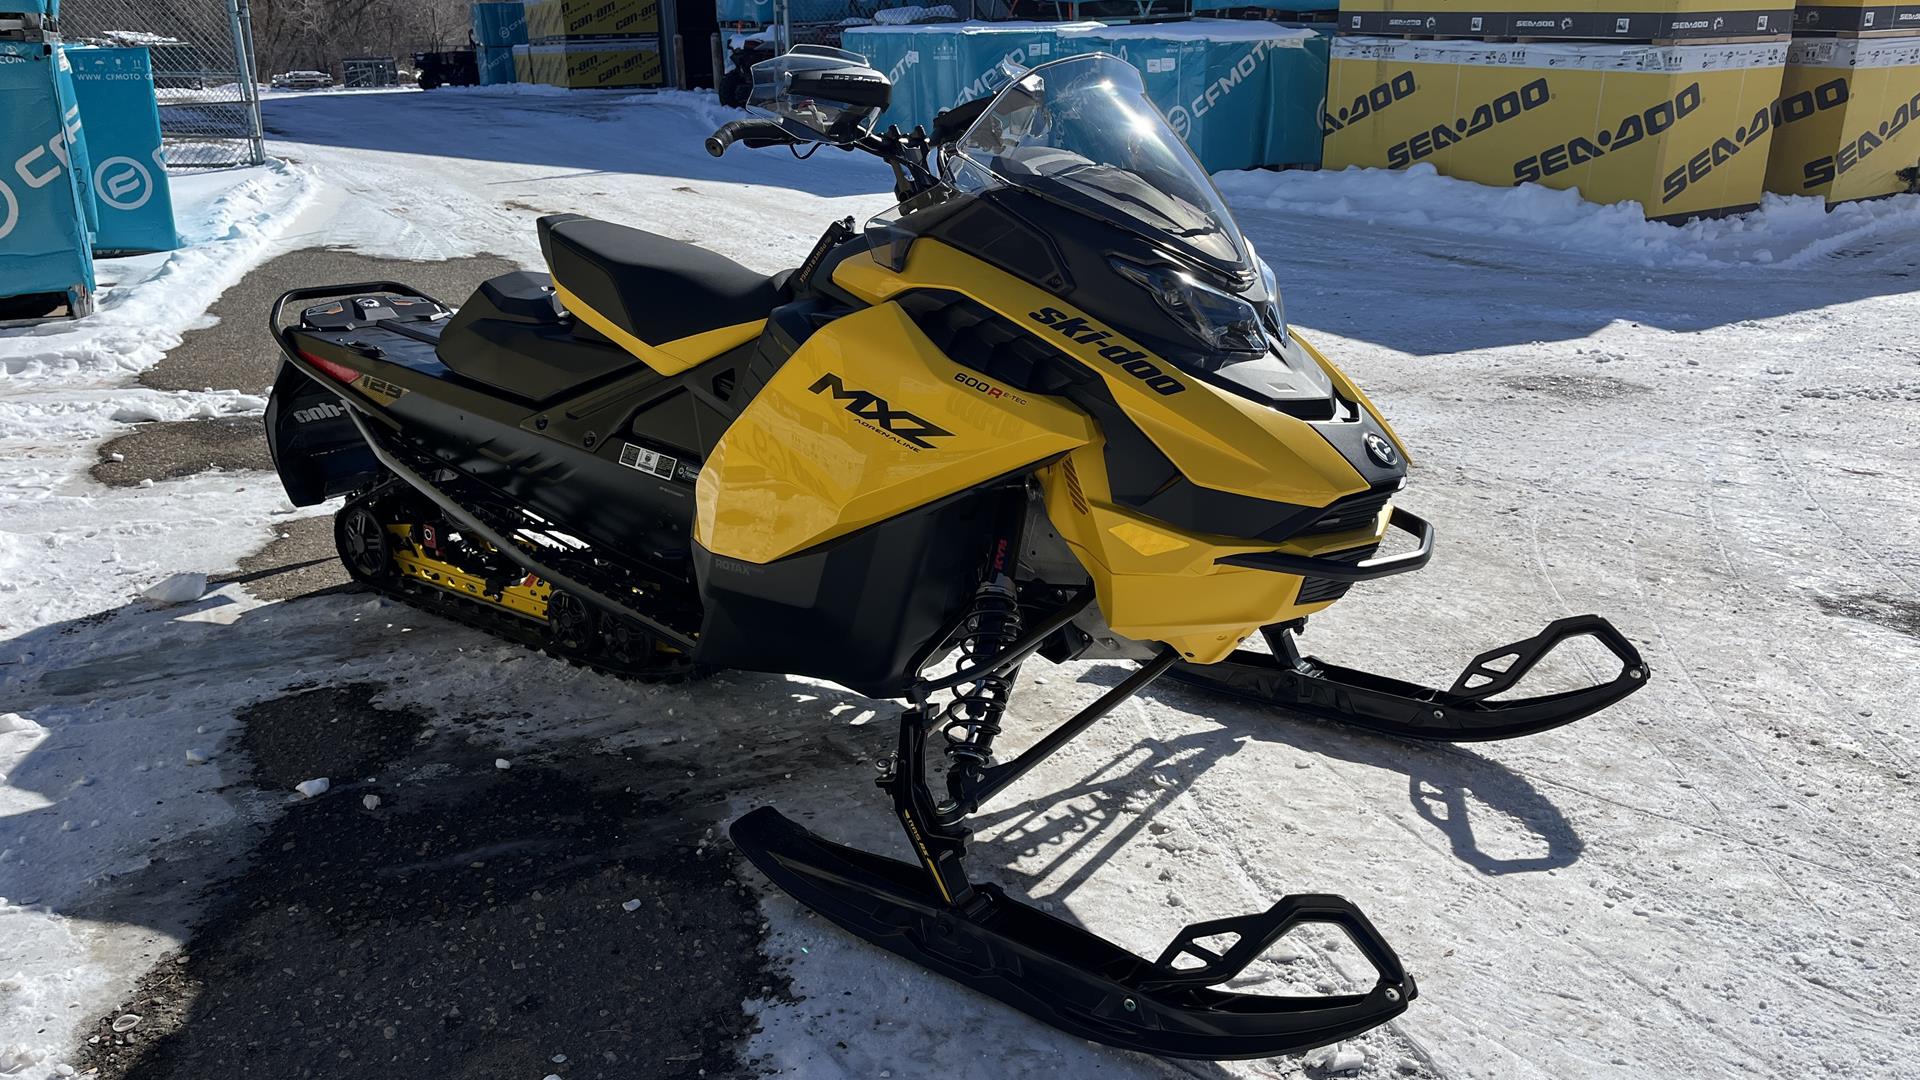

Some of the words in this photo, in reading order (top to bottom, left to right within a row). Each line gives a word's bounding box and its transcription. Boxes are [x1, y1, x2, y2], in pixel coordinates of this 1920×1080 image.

[1028, 306, 1186, 396] ski-doo
[364, 375, 401, 398] 129
[808, 372, 956, 448] MXZ
[854, 418, 921, 453] ADRENALINE
[715, 558, 752, 576] ROTAX
